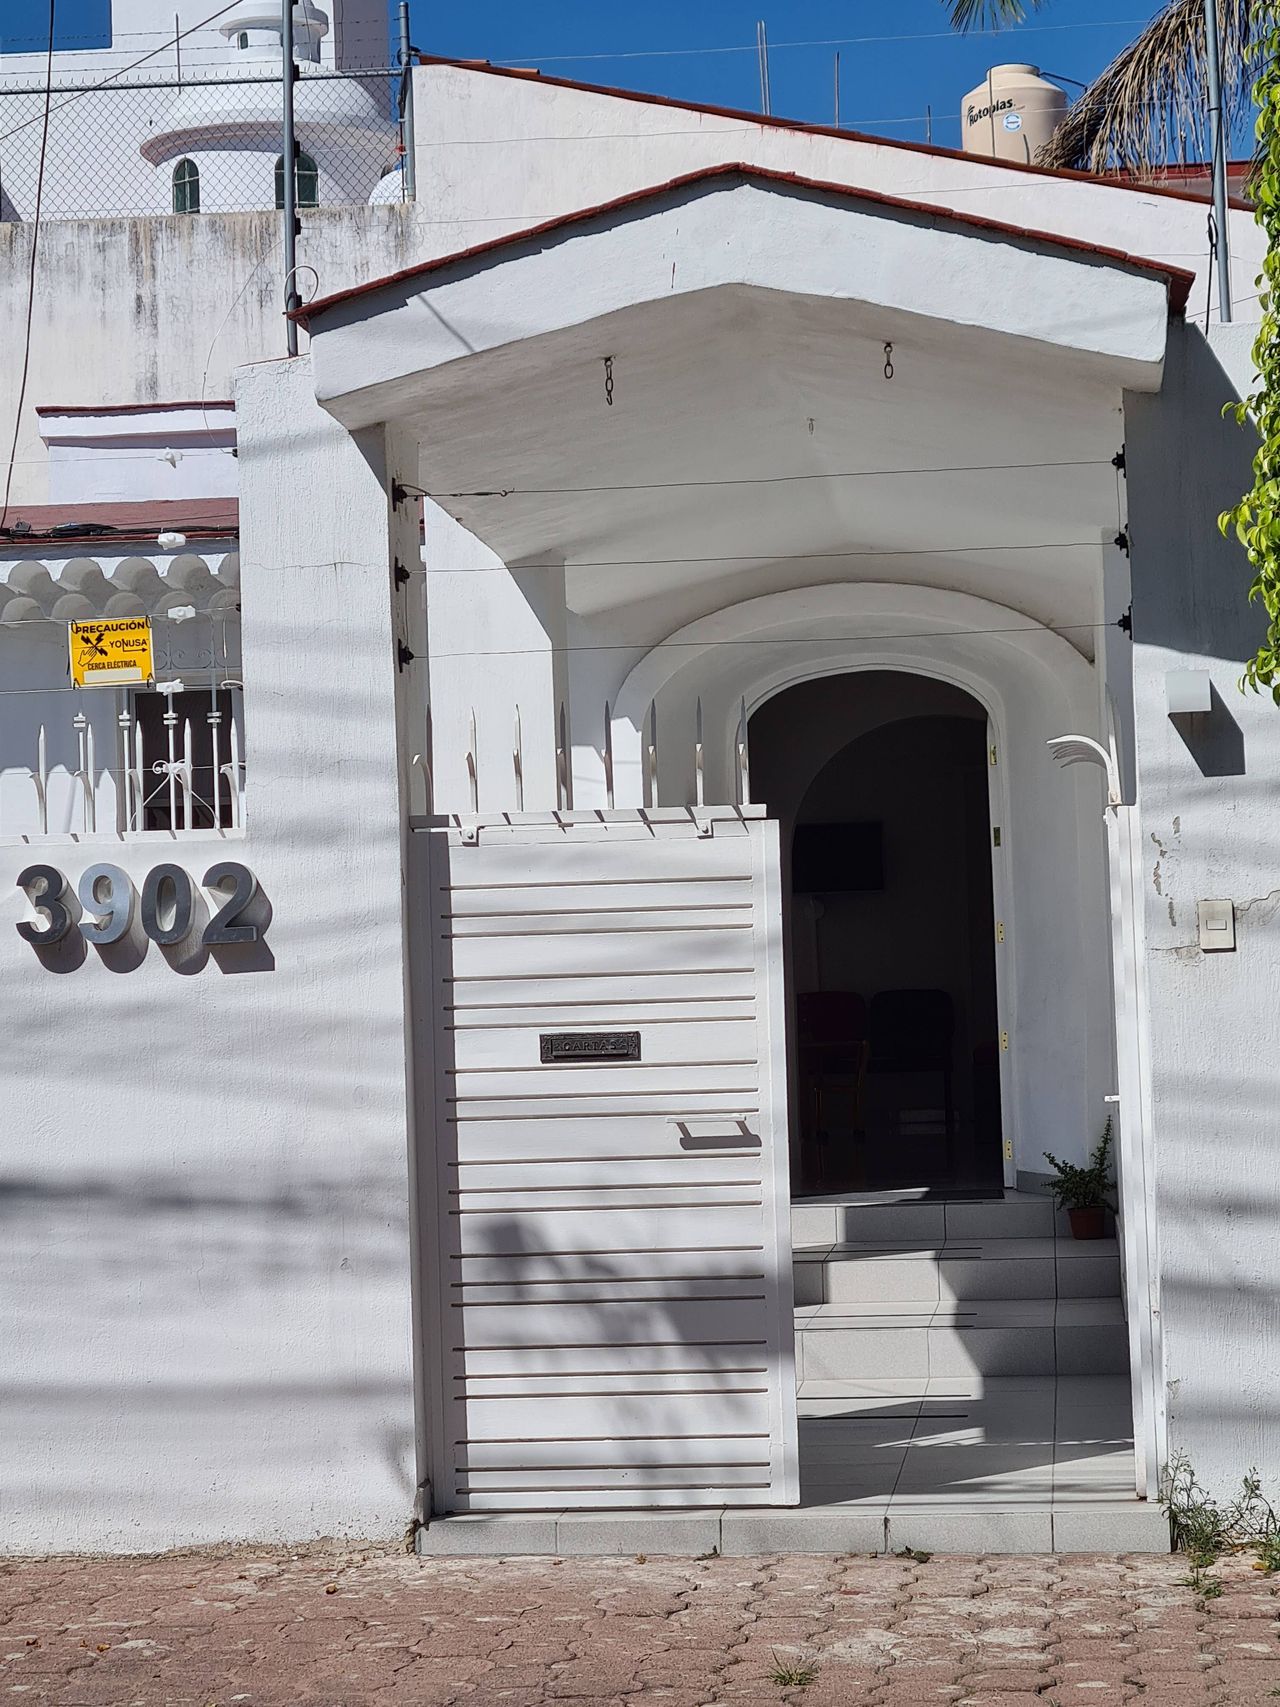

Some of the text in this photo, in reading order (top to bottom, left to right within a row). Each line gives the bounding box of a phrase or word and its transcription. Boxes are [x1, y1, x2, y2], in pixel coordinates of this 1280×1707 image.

[76, 620, 145, 634] PRECAUCIÓN
[109, 638, 147, 649] YONUSA
[87, 659, 137, 671] CERCA ELÉCTRICA
[16, 861, 257, 944] 3902
[563, 1039, 618, 1051] CARTAS
